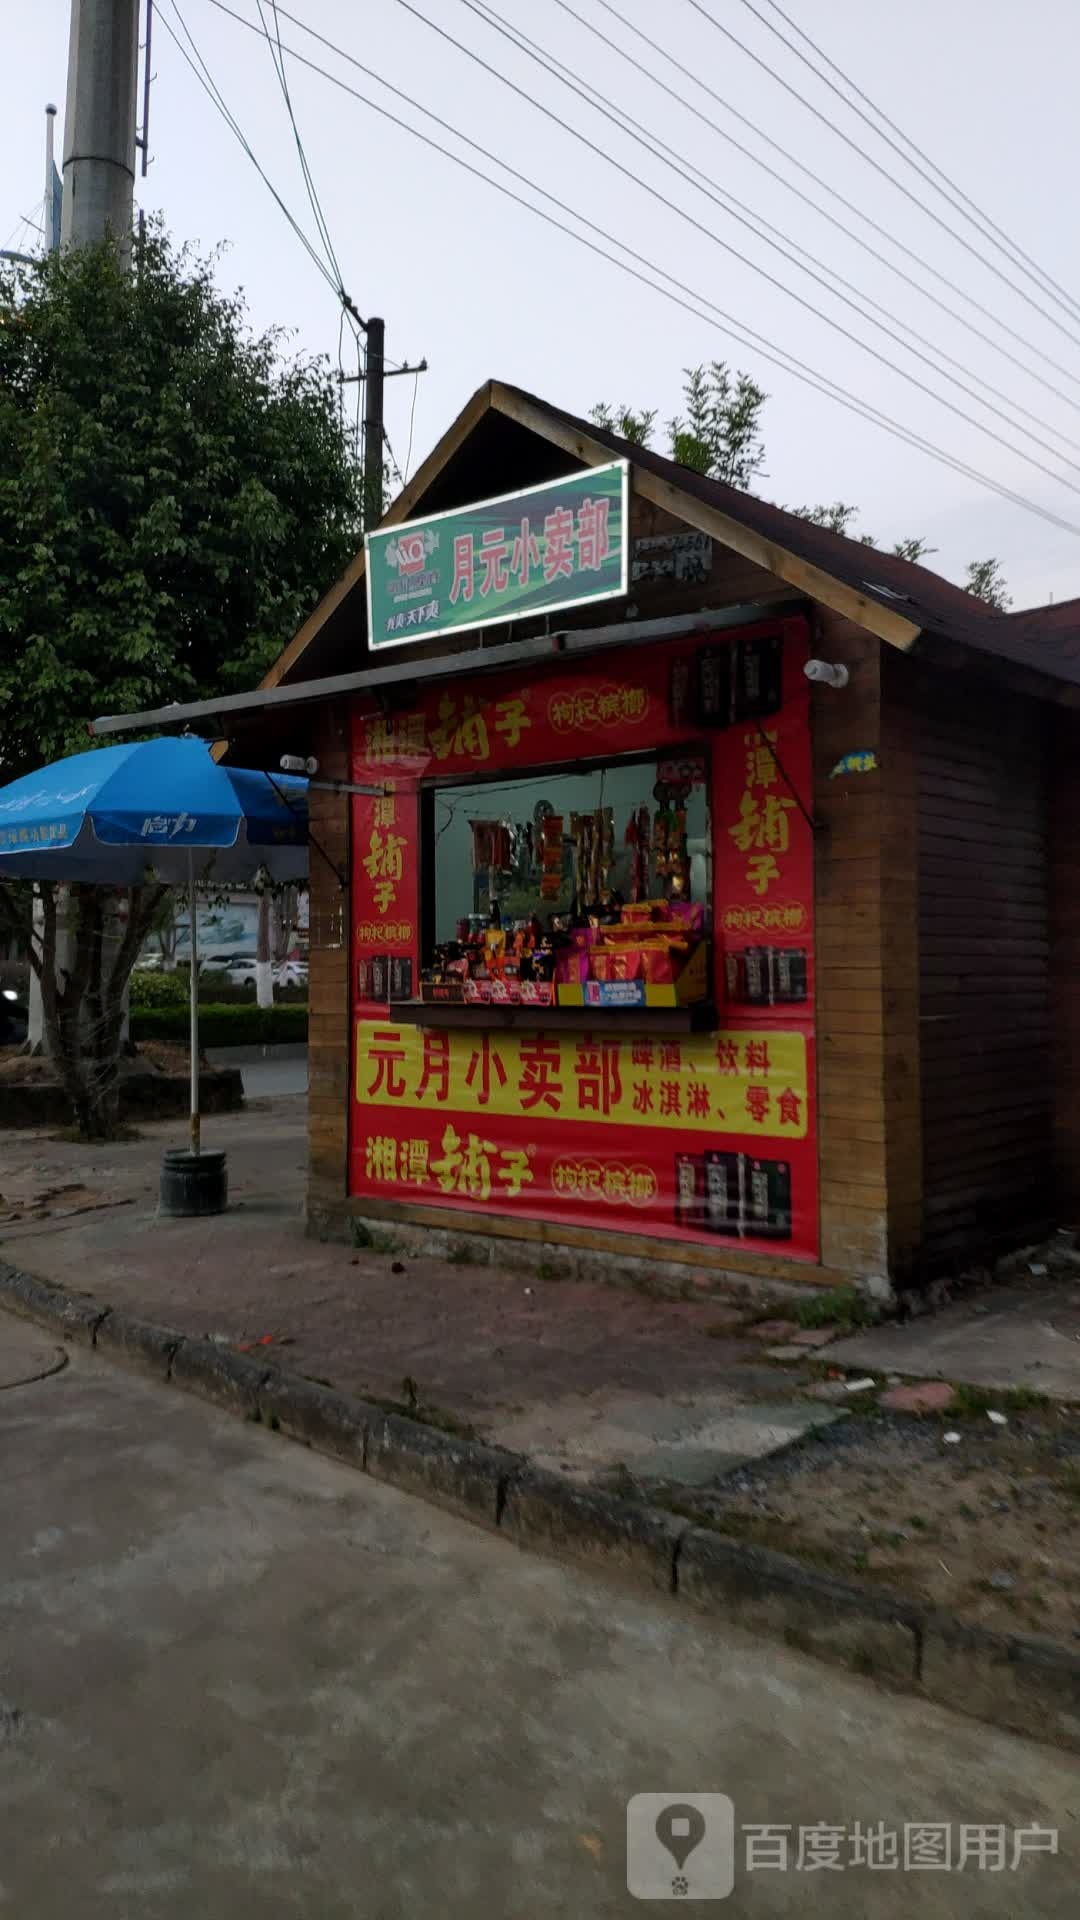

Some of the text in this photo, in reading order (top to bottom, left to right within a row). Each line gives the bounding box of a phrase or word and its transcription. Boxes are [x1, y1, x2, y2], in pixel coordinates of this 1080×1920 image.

[450, 498, 609, 604] 月元小卖部
[551, 686, 648, 729] 枸杞槟榔
[368, 1030, 622, 1115] 元月小卖部
[632, 1038, 771, 1078] 啤酒、饮料
[633, 1079, 802, 1126] 冰淇淋、零食
[365, 1121, 535, 1200] 湘潭铺子
